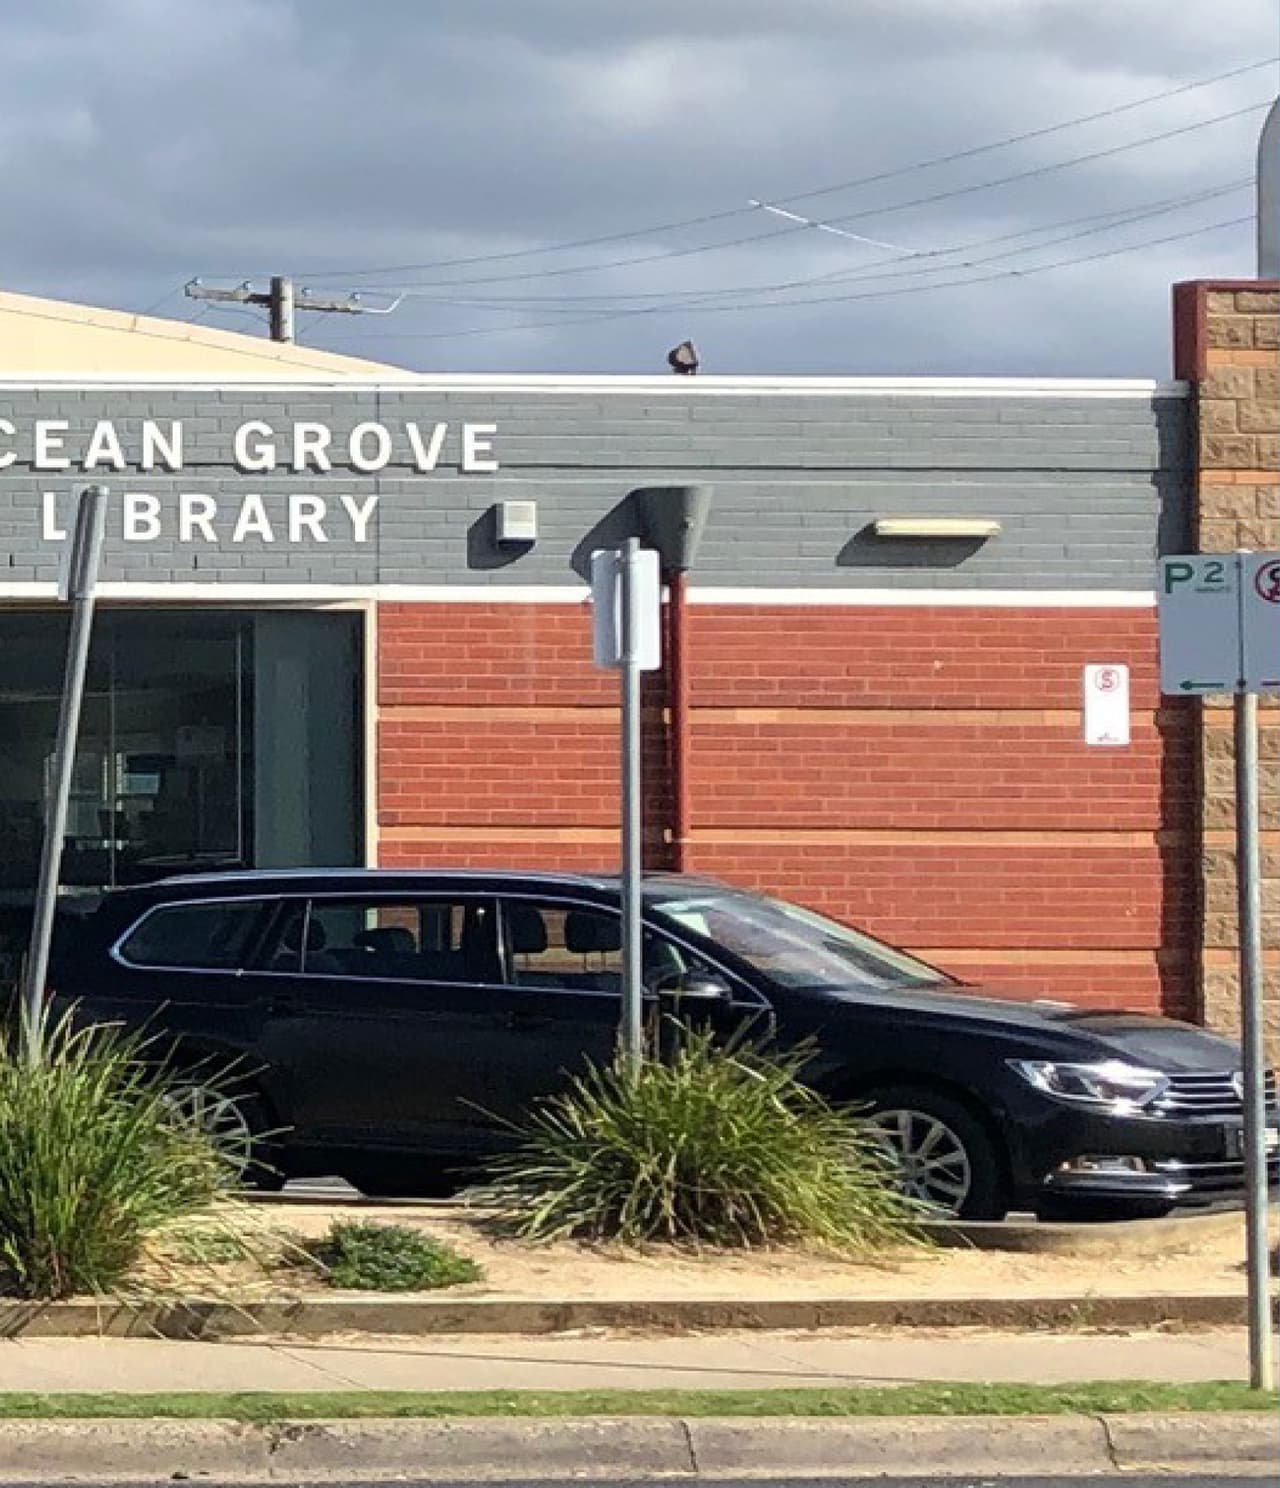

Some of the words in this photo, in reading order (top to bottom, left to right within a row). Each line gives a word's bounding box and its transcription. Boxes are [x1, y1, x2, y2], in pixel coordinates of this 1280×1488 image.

[233, 421, 498, 473] GROVE
[42, 492, 380, 543] LBRARY
[1164, 563, 1195, 594] P
[1203, 561, 1225, 583] 2
